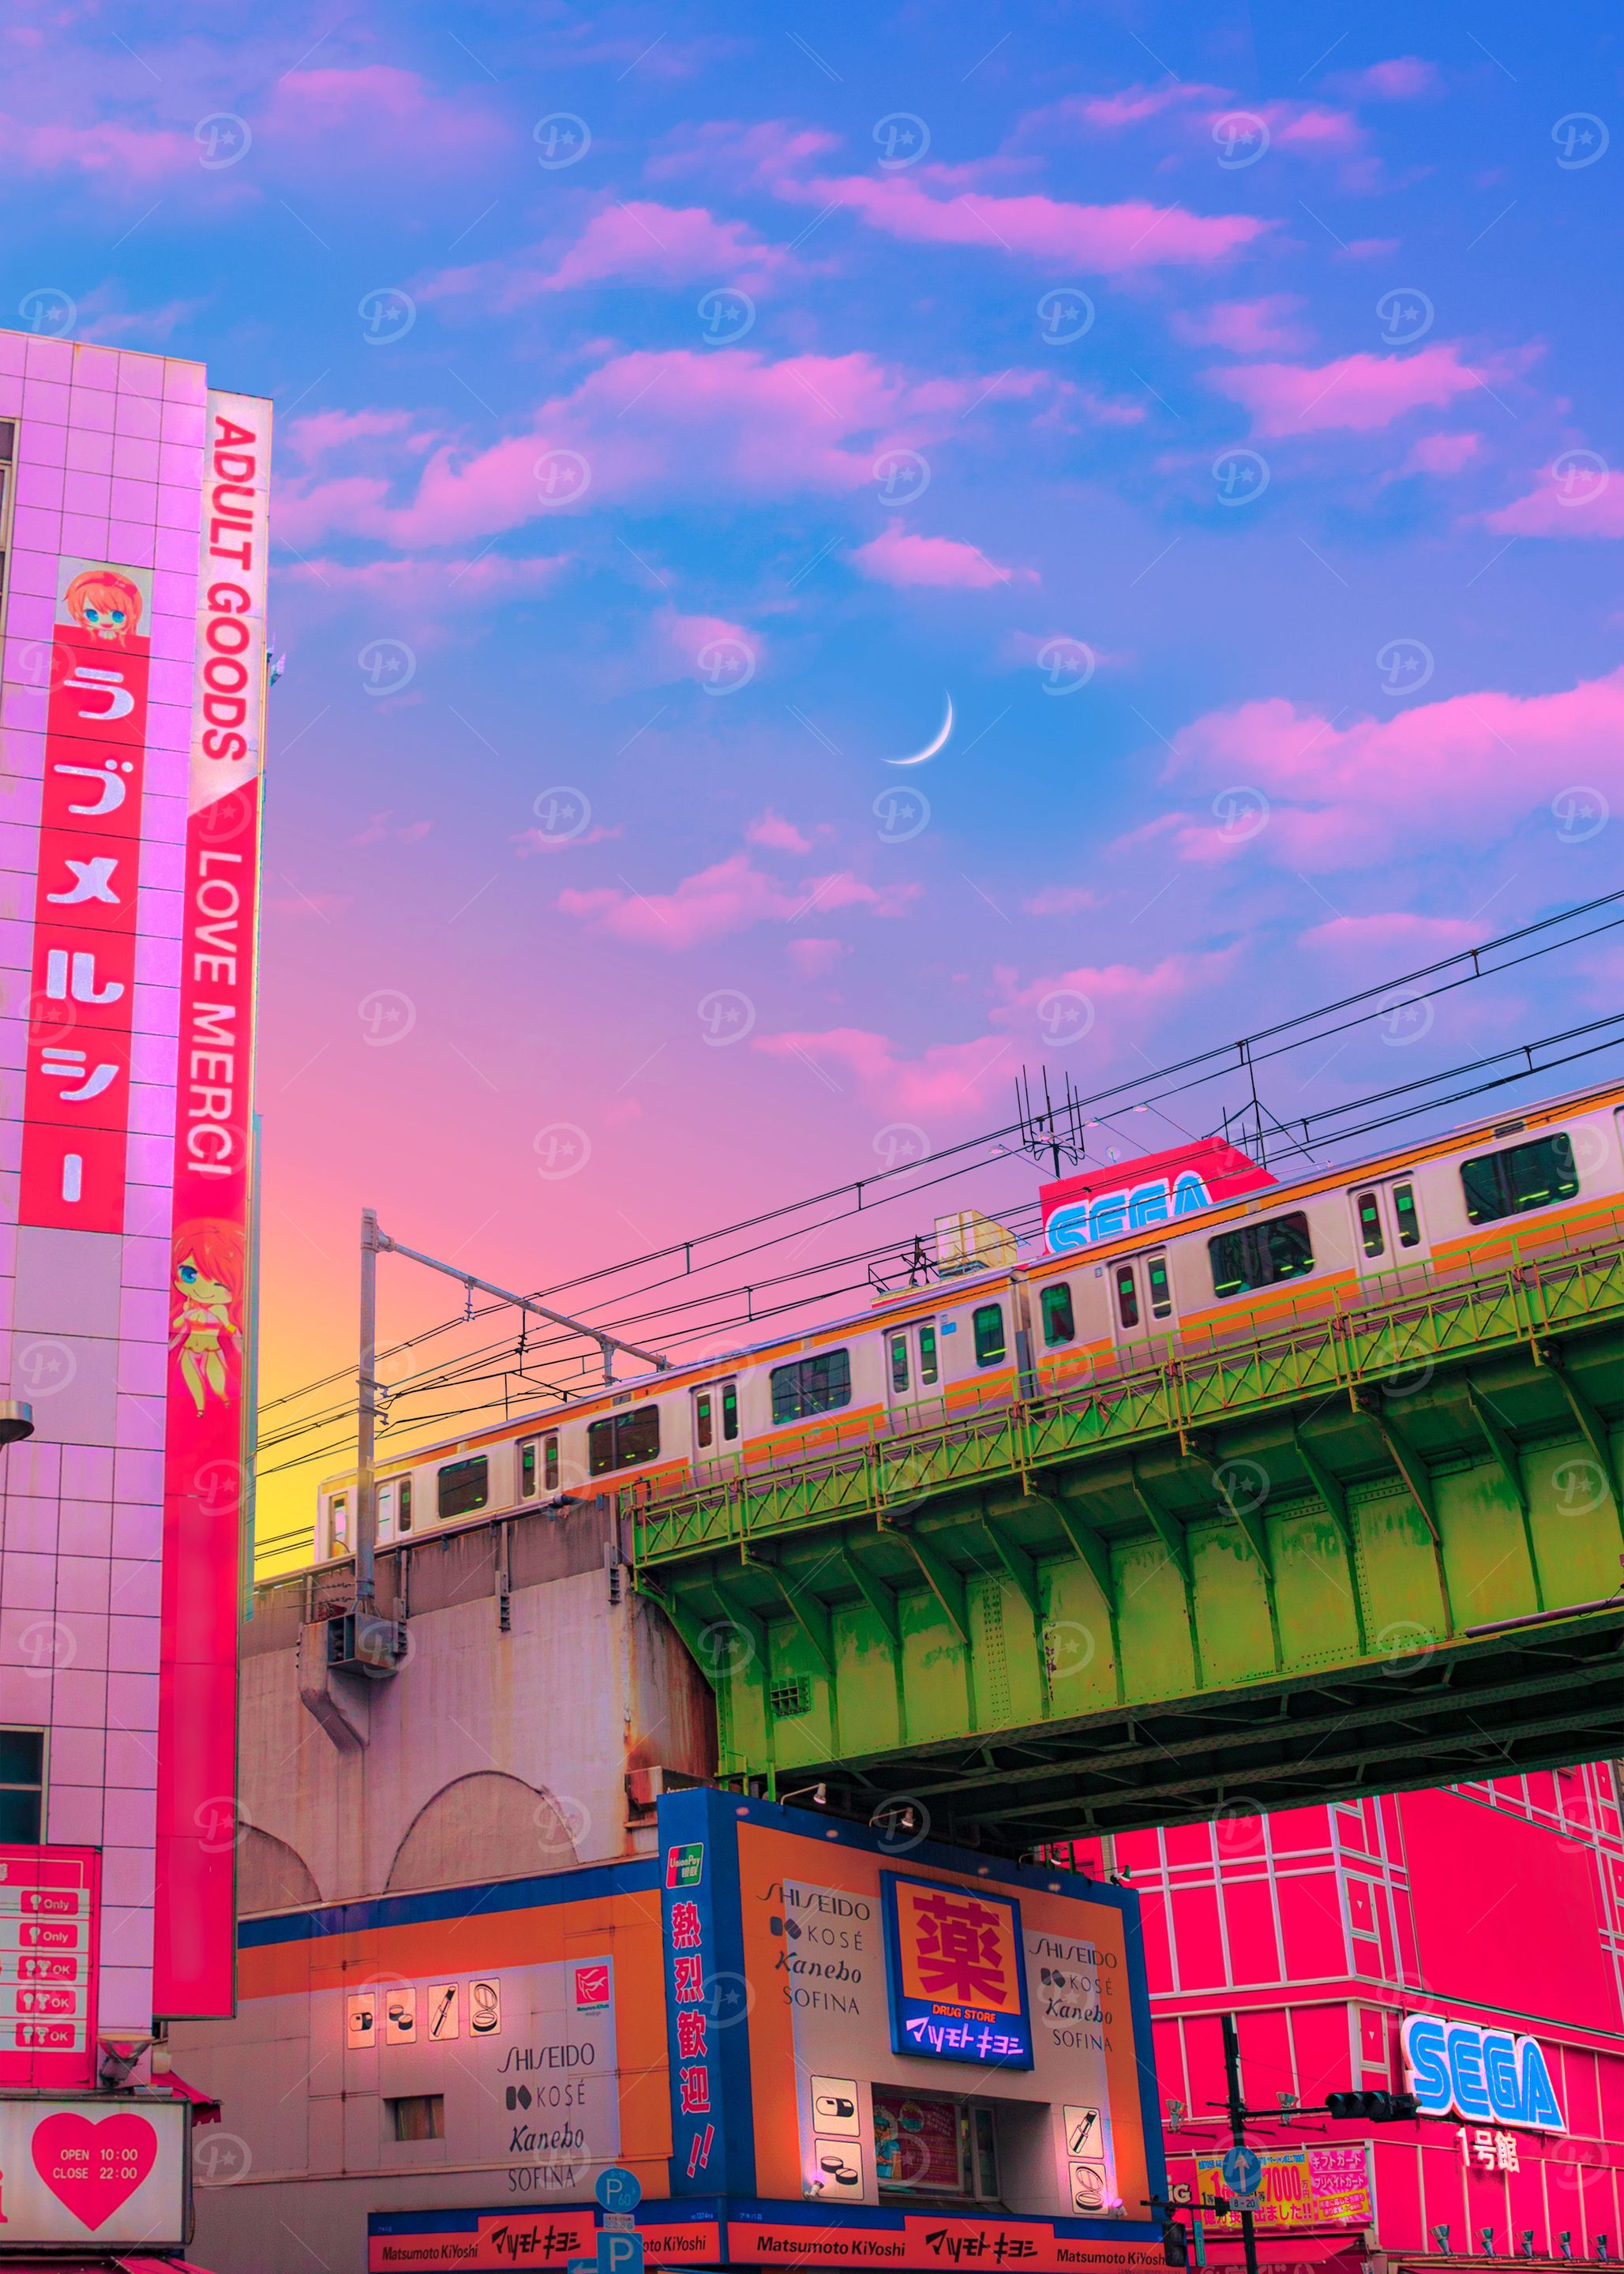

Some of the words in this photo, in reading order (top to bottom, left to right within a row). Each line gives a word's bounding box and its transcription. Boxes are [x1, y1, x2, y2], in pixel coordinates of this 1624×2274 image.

[209, 415, 257, 572] ADULT
[201, 581, 252, 762] GOODS
[194, 850, 242, 987] LOVE
[41, 666, 134, 1202] ラブメルシー
[187, 1001, 236, 1176] MERCI
[669, 1855, 700, 1868] UnionPay
[43, 1898, 69, 1911] Only
[756, 1883, 870, 1920] SHISEIDO
[43, 1931, 69, 1943] Only
[808, 1925, 863, 1951] KOSÉ
[913, 1894, 1007, 2005] 薬
[775, 1950, 861, 1983] Kanebo
[1029, 1938, 1117, 1968] SHISEIDO
[53, 1964, 70, 1975] OK
[1069, 1974, 1113, 1996] KOSÉ
[51, 1998, 69, 2008] OK
[783, 1986, 860, 2015] SOFINA
[932, 2003, 962, 2018] DRUG
[964, 2009, 996, 2024] STORE
[1045, 1997, 1112, 2024] Kanebo
[50, 2031, 68, 2042] OK
[906, 2016, 1024, 2058] マツモトキヨシ
[1052, 2028, 1113, 2052] SOFINA
[497, 2043, 594, 2073] SHISEIDO
[1403, 2014, 1566, 2131] SEGA
[537, 2078, 585, 2108] KOSÉ
[509, 2122, 584, 2152] Kanebo
[1456, 2127, 1520, 2173] 1号館
[60, 2148, 90, 2161] OPEN
[99, 2148, 138, 2161] 10:00
[52, 2167, 88, 2179] CLOSE
[99, 2167, 137, 2180] 22:00
[508, 2166, 576, 2192] SOFINA
[606, 2178, 622, 2205] P
[618, 2194, 631, 2206] 60
[382, 2246, 439, 2261] Matsumoto
[441, 2243, 478, 2259] KiYoshi
[492, 2225, 581, 2261] マツモトキヨシ
[610, 2237, 634, 2272] P
[664, 2235, 707, 2251] KiYoshi
[756, 2235, 849, 2254] Matsumoto
[851, 2239, 906, 2257] KiYoshi
[925, 2228, 1038, 2264] マツモトキヨシ
[1056, 2248, 1126, 2265] Matsumoto
[1127, 2252, 1166, 2265] KiYosh
